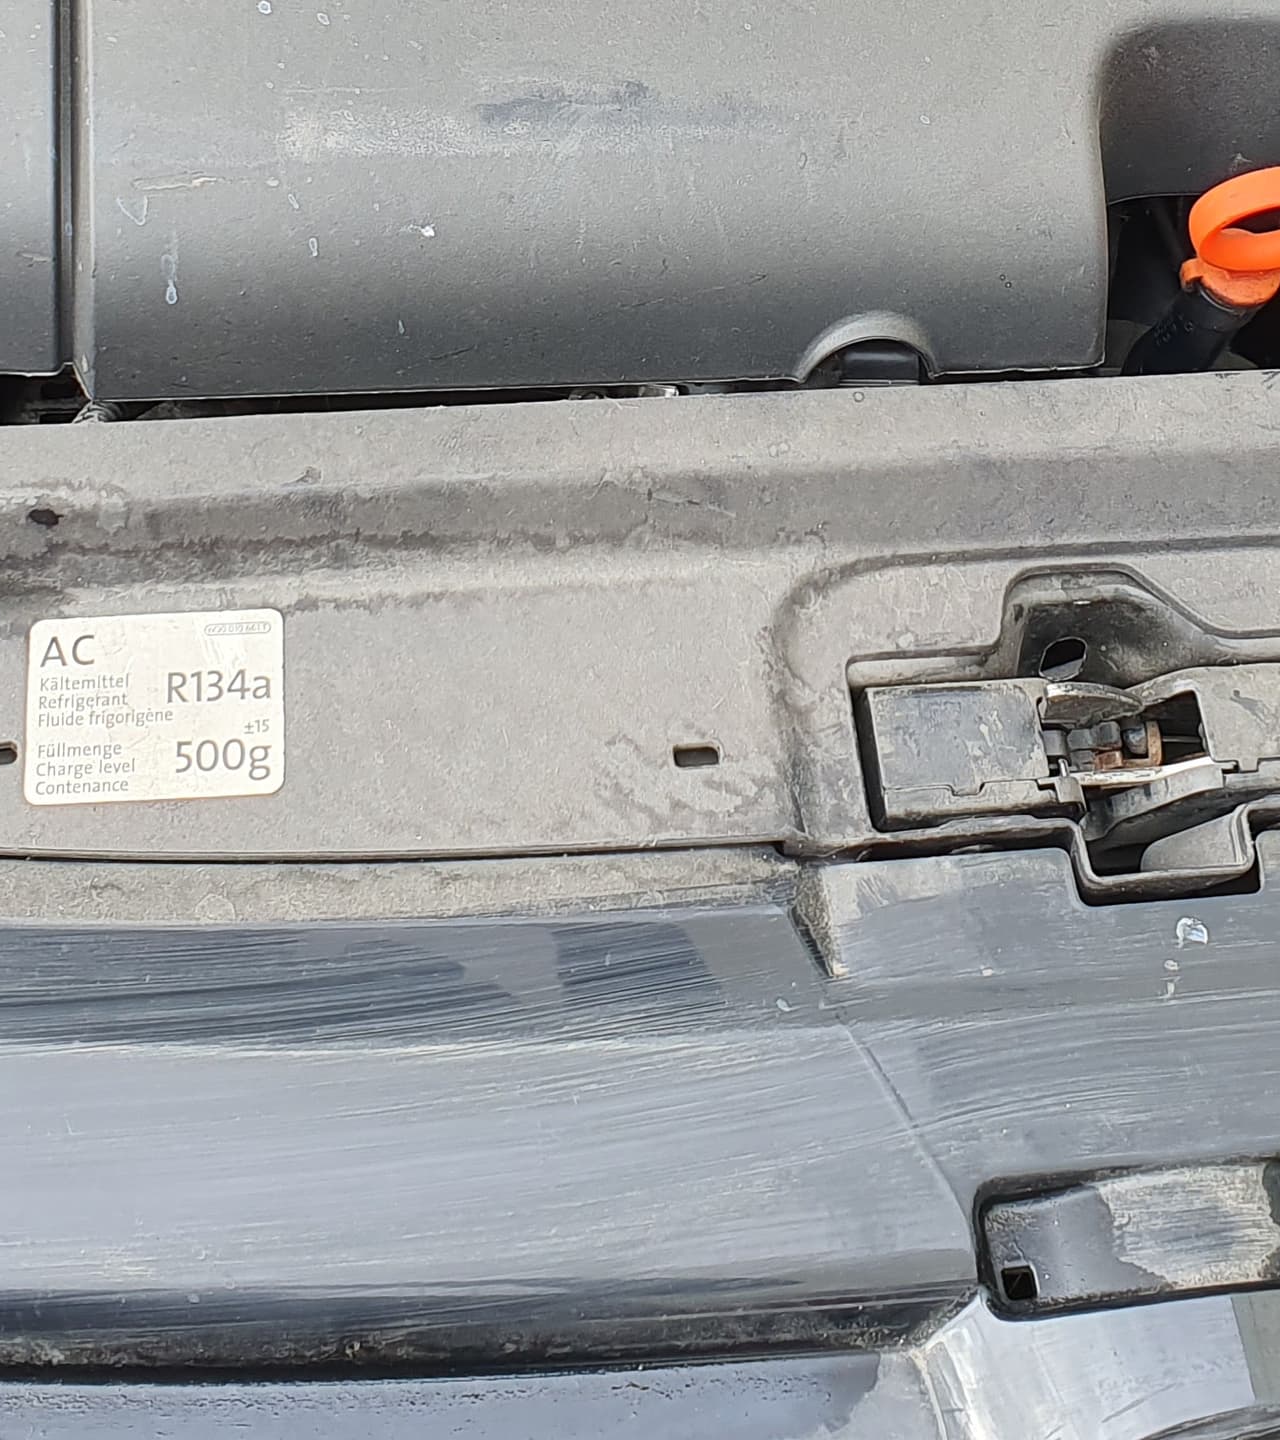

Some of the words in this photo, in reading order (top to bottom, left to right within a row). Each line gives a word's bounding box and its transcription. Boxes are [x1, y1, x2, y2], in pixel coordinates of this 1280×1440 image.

[40, 634, 94, 667] AC
[40, 673, 129, 691] Kältemittel
[167, 669, 271, 703] R134a
[39, 693, 128, 712] Refrigerant
[38, 710, 84, 728] Fluide
[89, 708, 173, 729] frigorigène
[38, 742, 122, 760] Füllmenge
[176, 739, 271, 781] 500g
[36, 761, 93, 780] Charge
[99, 757, 135, 774] level
[35, 780, 129, 795] Contenance
